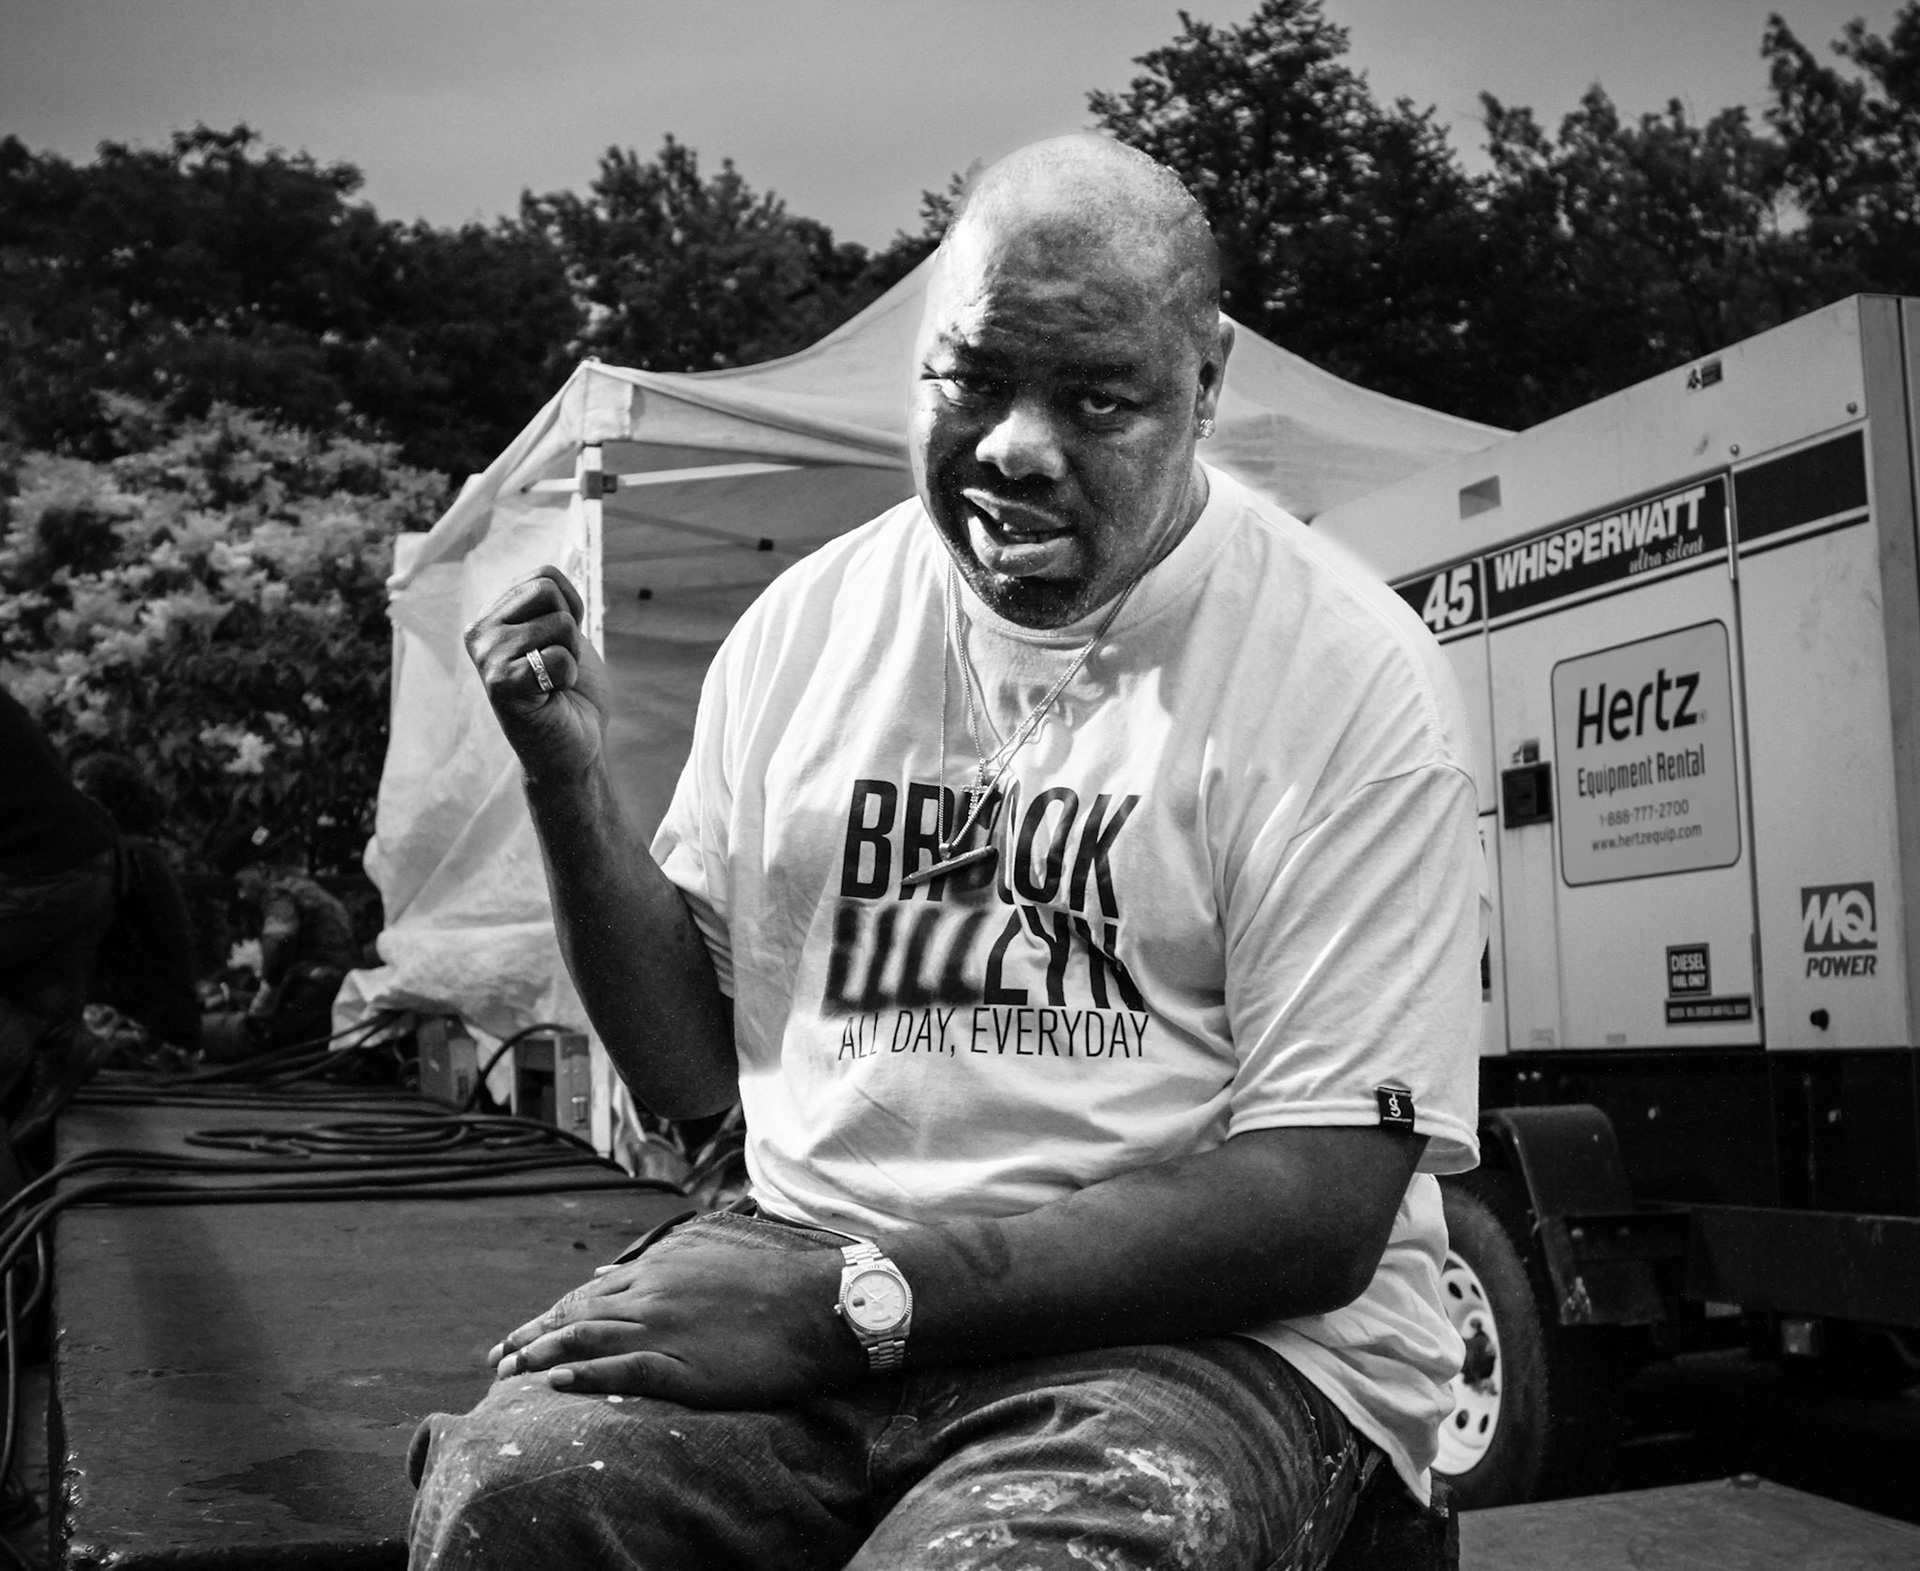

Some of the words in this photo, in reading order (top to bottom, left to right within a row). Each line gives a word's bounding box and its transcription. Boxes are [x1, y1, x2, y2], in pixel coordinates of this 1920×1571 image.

[1494, 486, 1706, 592] WHISPERWATT
[1629, 546, 1662, 574] ultra
[1665, 534, 1705, 563] silent
[1422, 564, 1474, 631] 45
[1577, 668, 1700, 749] Hertz
[1577, 755, 1653, 799] Equipment
[1657, 743, 1705, 783] Rental
[1592, 824, 1702, 851] www.hertzequip.com
[1600, 798, 1690, 827] 1-888-777-2700
[1802, 889, 1877, 945] MQ
[1671, 952, 1706, 972] DIESEL
[1806, 954, 1877, 978] POWER
[838, 1012, 879, 1060] ALL
[891, 1007, 956, 1057] DAY,
[971, 1007, 1149, 1058] EVERYDAY
